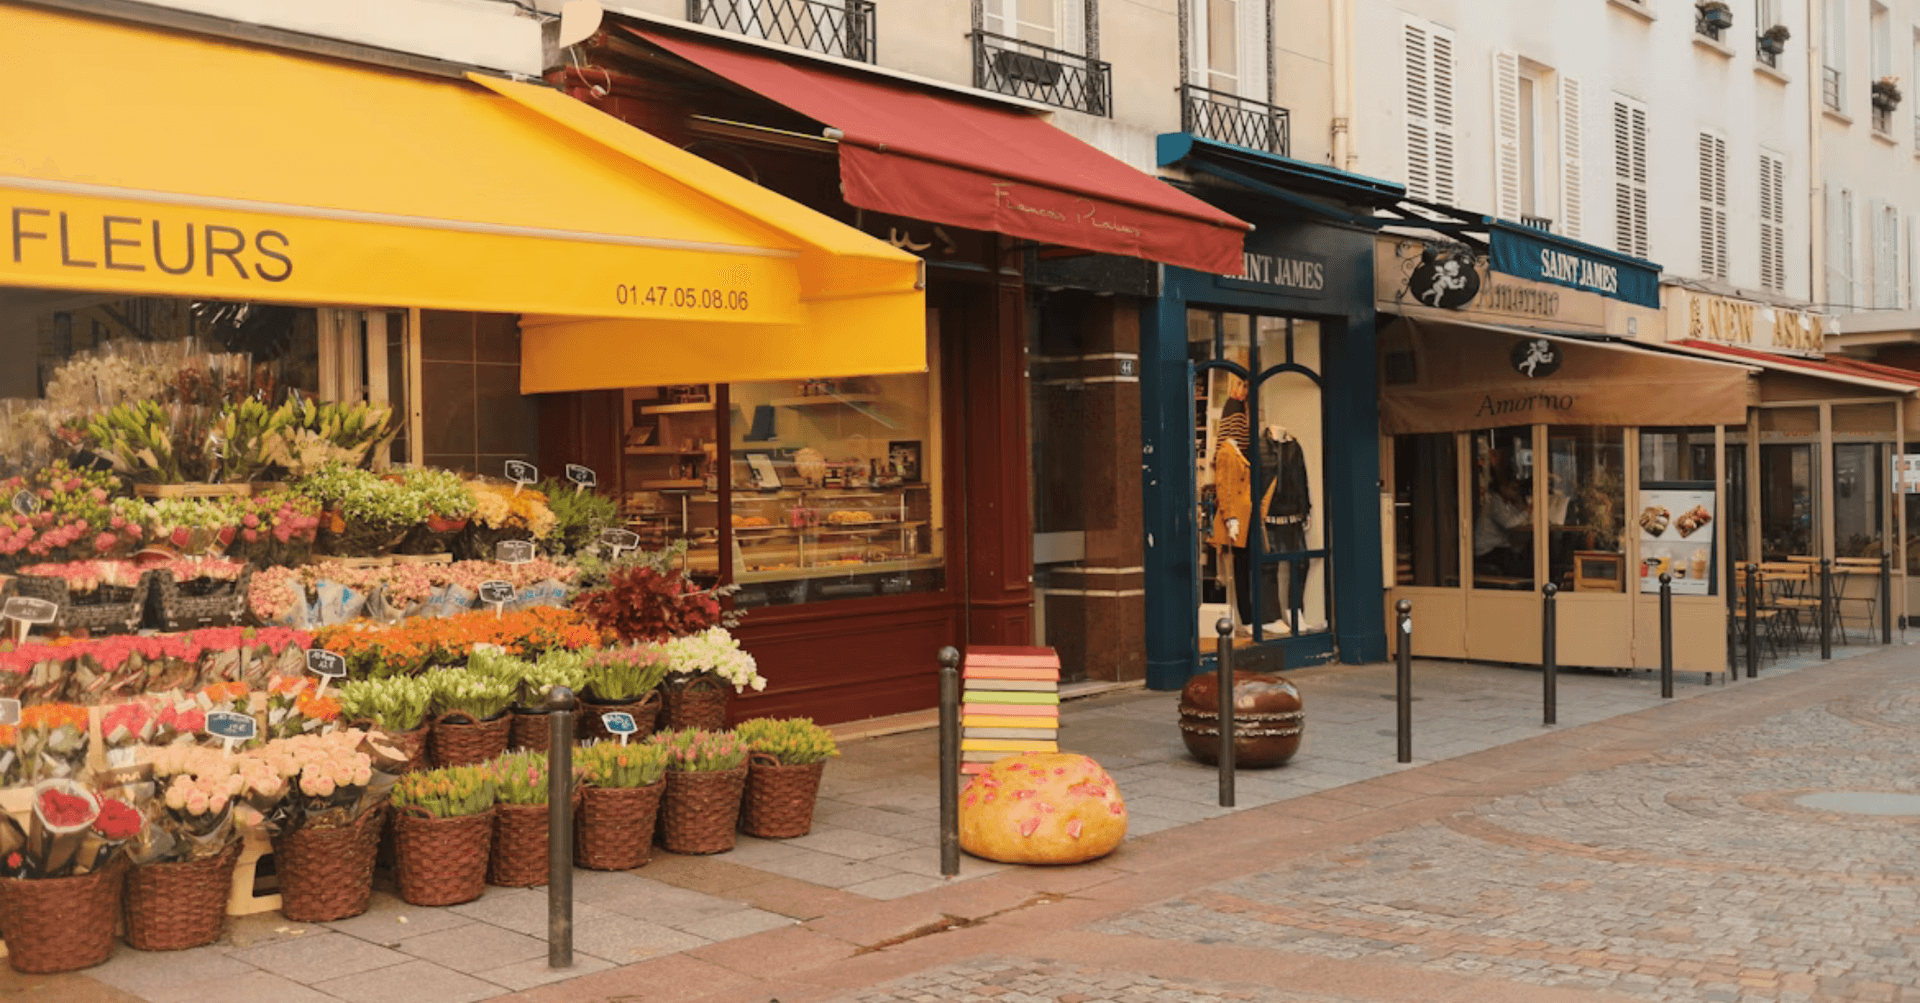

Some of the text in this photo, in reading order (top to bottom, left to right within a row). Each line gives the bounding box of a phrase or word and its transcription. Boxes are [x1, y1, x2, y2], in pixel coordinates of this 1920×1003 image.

[12, 206, 293, 282] FLEURS
[1223, 252, 1324, 290] INT JAMES
[1541, 249, 1618, 293] SAINT JAMES
[616, 284, 748, 310] 01.47.05.08.06
[1708, 298, 1753, 343] NEW
[1475, 394, 1573, 417] Amorino
